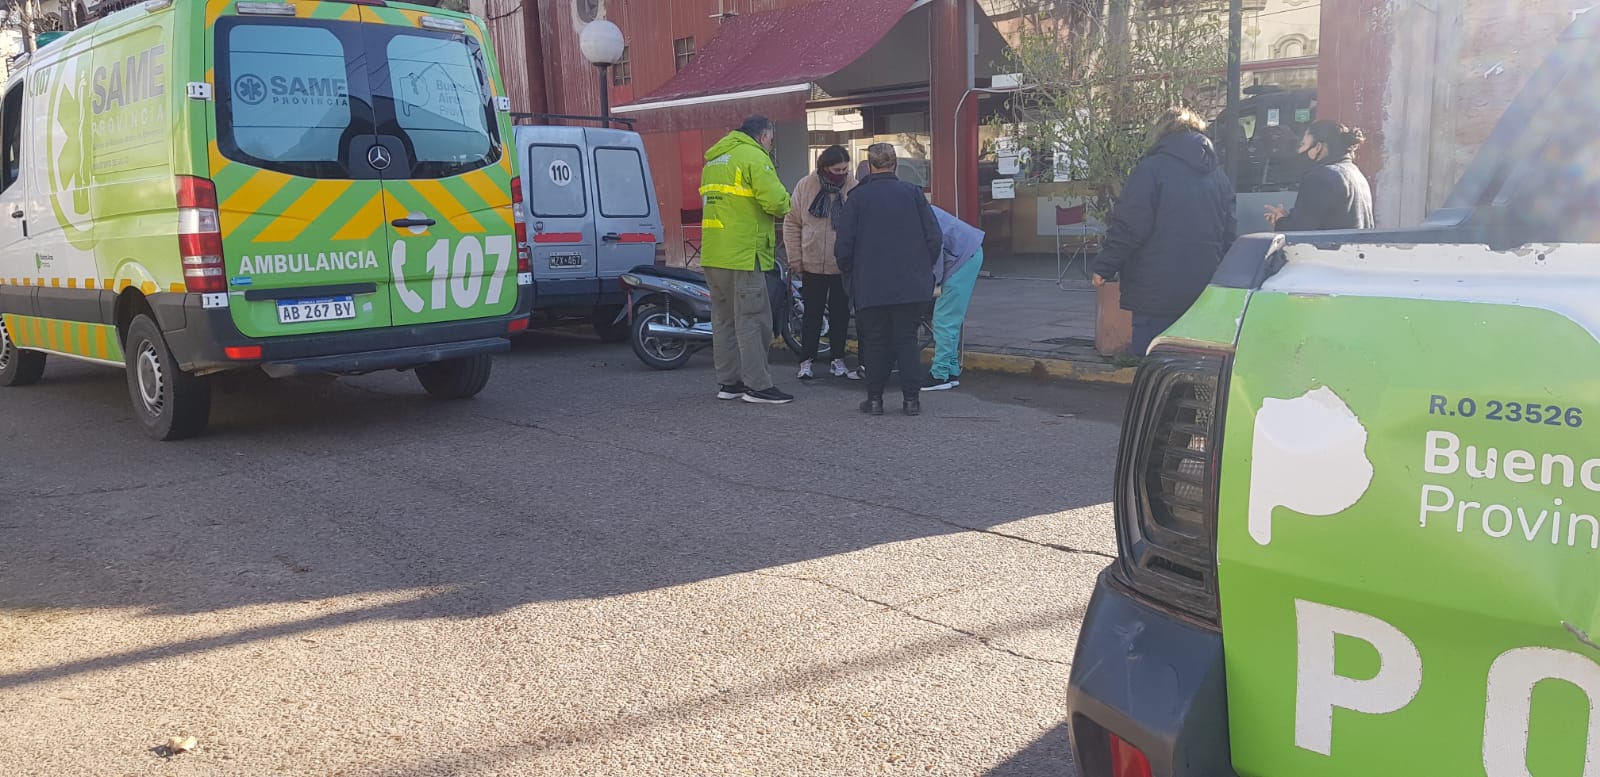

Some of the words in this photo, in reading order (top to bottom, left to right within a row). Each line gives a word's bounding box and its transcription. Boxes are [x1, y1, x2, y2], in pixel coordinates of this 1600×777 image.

[35, 67, 52, 97] 107
[91, 44, 165, 115] SAME
[270, 75, 347, 98] SAME
[272, 96, 348, 106] PROVINCIA
[91, 105, 164, 136] PROVINCIA
[551, 164, 570, 182] 110
[239, 250, 378, 275] AMBULANCIA
[425, 235, 513, 310] 107
[283, 306, 300, 321] AB
[304, 304, 330, 319] 267
[334, 302, 351, 317] BY
[1485, 400, 1583, 428] 23526
